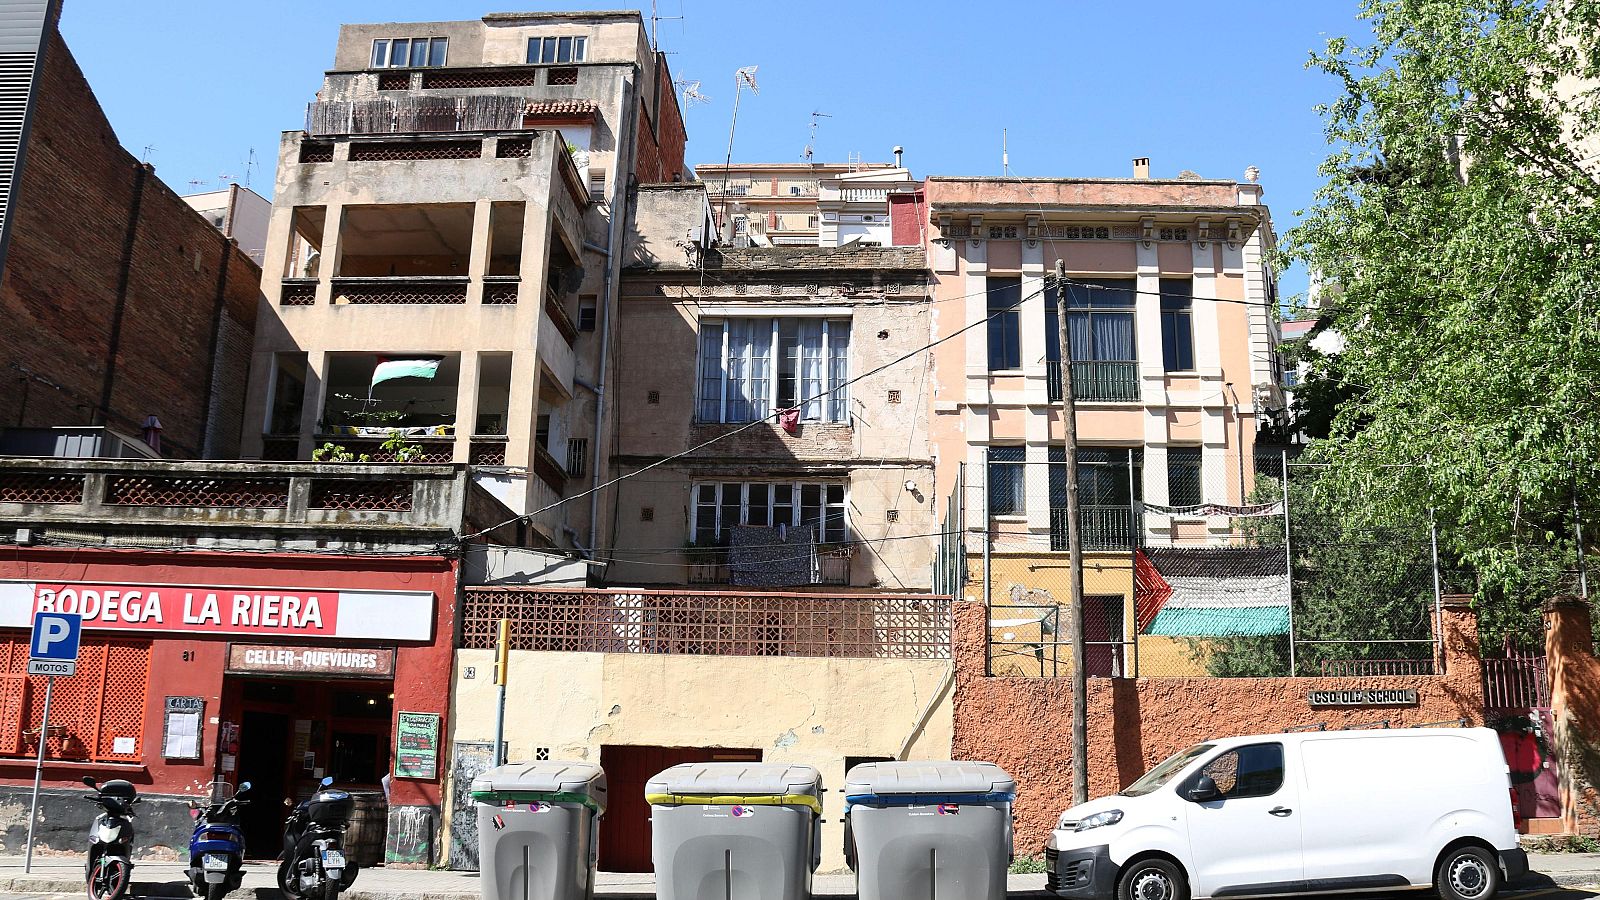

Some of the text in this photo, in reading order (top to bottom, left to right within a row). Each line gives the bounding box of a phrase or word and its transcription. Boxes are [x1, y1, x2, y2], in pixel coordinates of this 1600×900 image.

[37, 588, 323, 629] BODEGA LA RIERA
[38, 616, 70, 654] P
[182, 650, 195, 662] 81
[245, 650, 377, 668] CELLER-QUEVIURES
[35, 663, 68, 673] MOTOS
